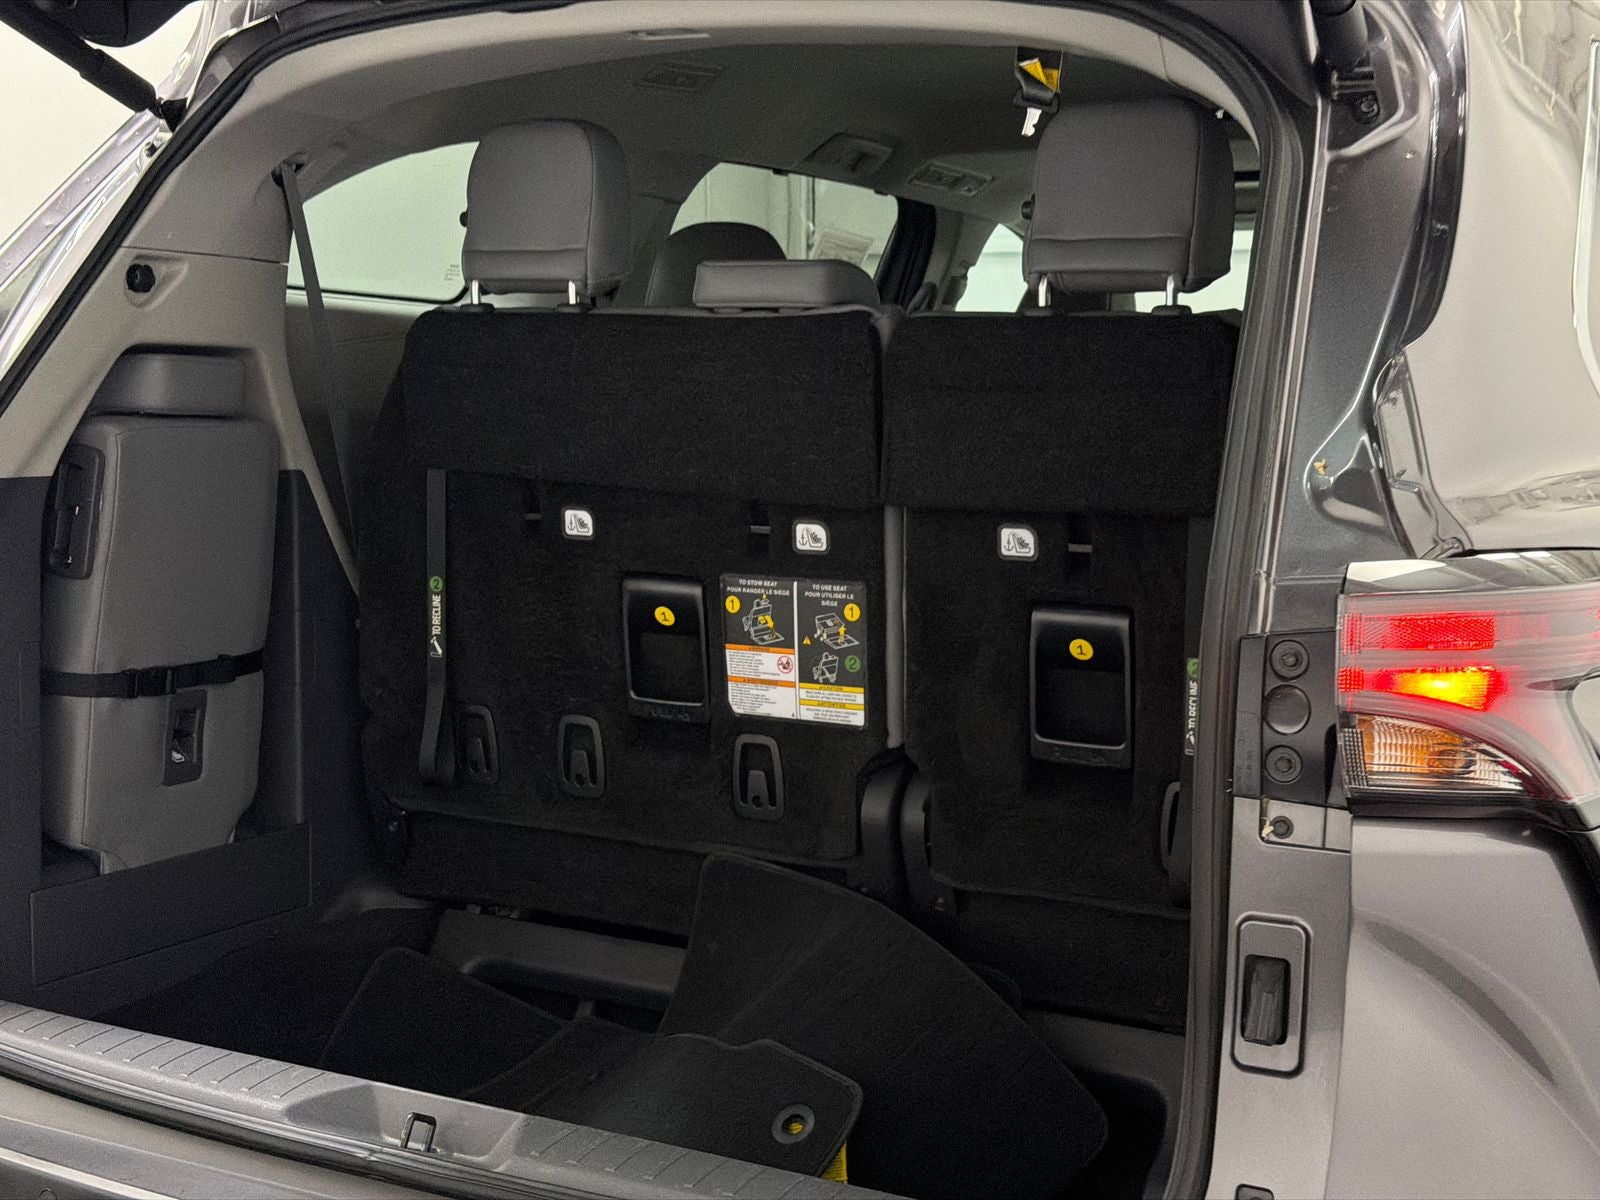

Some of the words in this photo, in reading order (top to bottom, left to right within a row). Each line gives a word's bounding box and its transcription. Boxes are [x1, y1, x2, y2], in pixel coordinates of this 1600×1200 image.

[747, 579, 763, 587] STOW
[432, 594, 441, 625] RECLINE
[432, 625, 441, 635] TO
